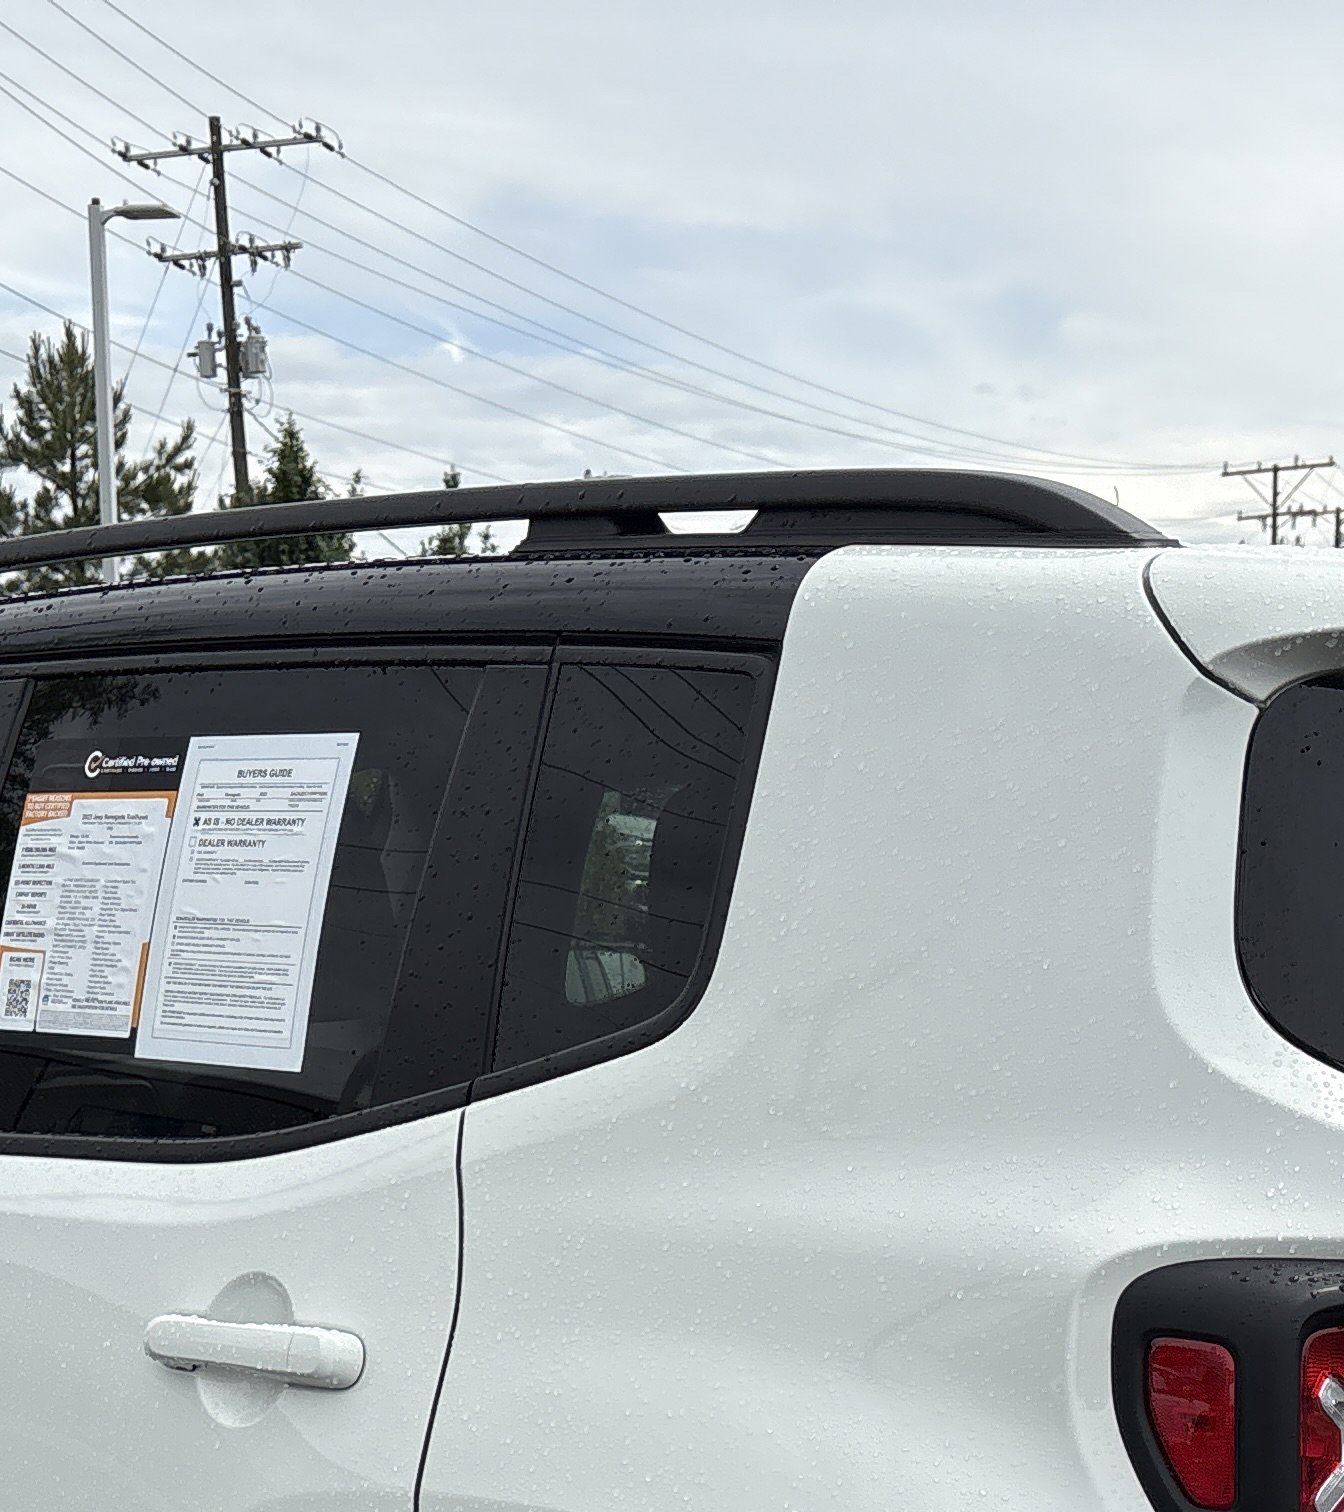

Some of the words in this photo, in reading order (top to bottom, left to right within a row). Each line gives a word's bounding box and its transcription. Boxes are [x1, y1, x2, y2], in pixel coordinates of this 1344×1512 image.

[237, 769, 268, 779] BUYERS
[269, 768, 294, 778] GUIDE
[202, 818, 212, 826] AS
[236, 818, 265, 826] DEALER
[266, 818, 306, 827] WARRANTY
[198, 839, 225, 847] DEALER
[227, 839, 266, 848] WARRANTY
